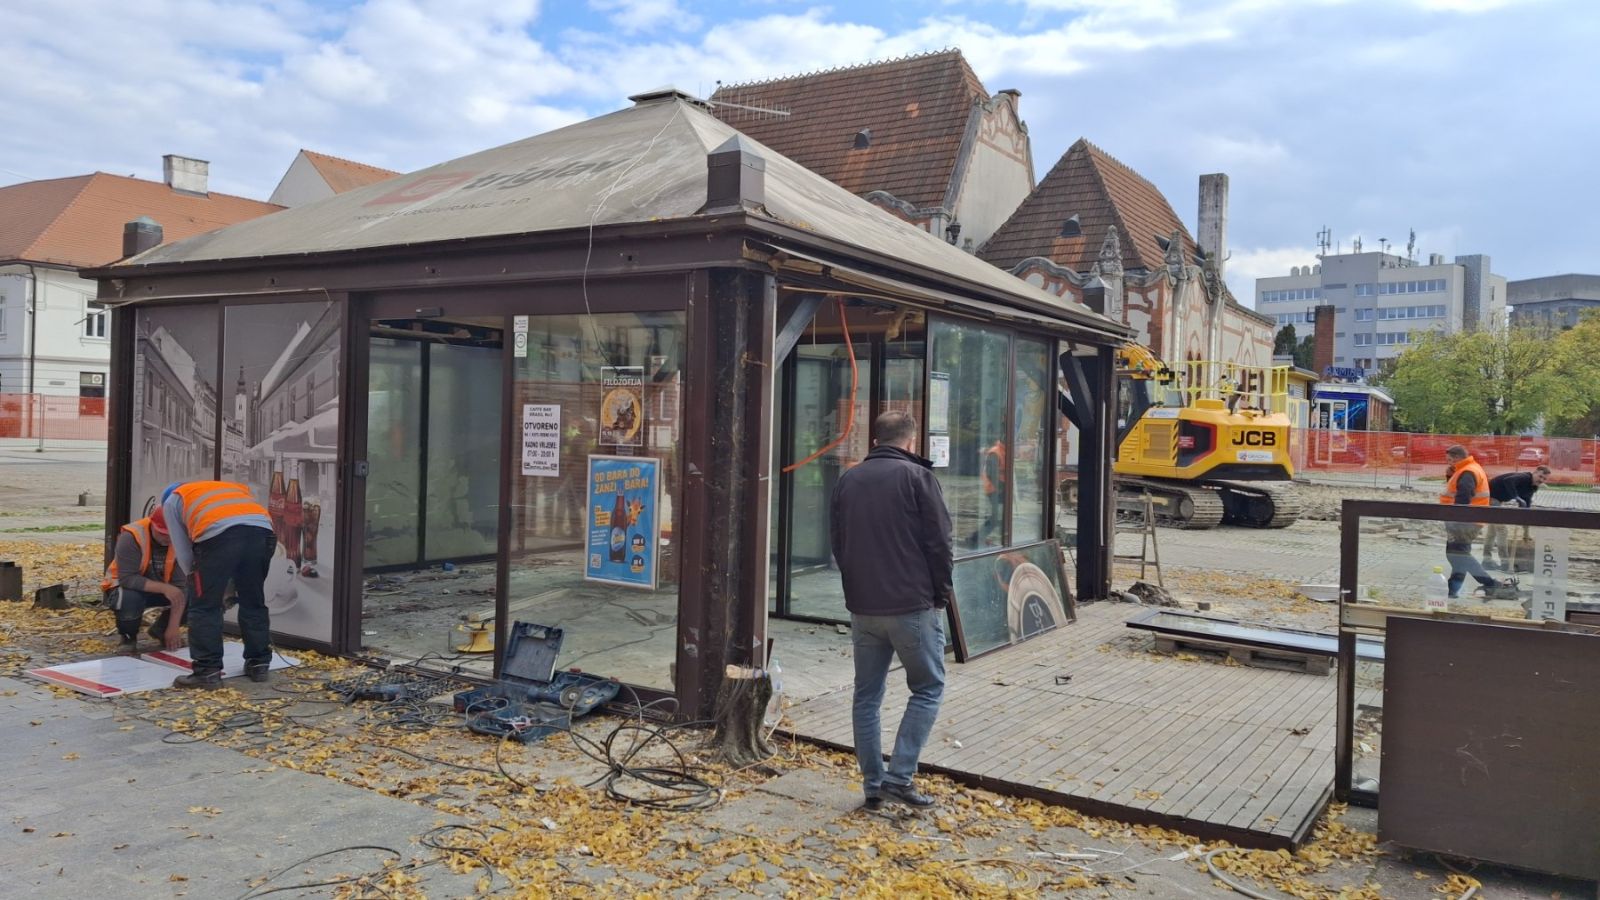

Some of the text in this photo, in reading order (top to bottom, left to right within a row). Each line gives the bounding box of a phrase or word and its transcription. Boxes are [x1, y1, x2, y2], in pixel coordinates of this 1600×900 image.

[604, 378, 642, 386] FILOZOFIJA
[525, 422, 558, 430] OTVORENO
[1232, 431, 1276, 446] JCB
[594, 467, 640, 482] OD BARA DO
